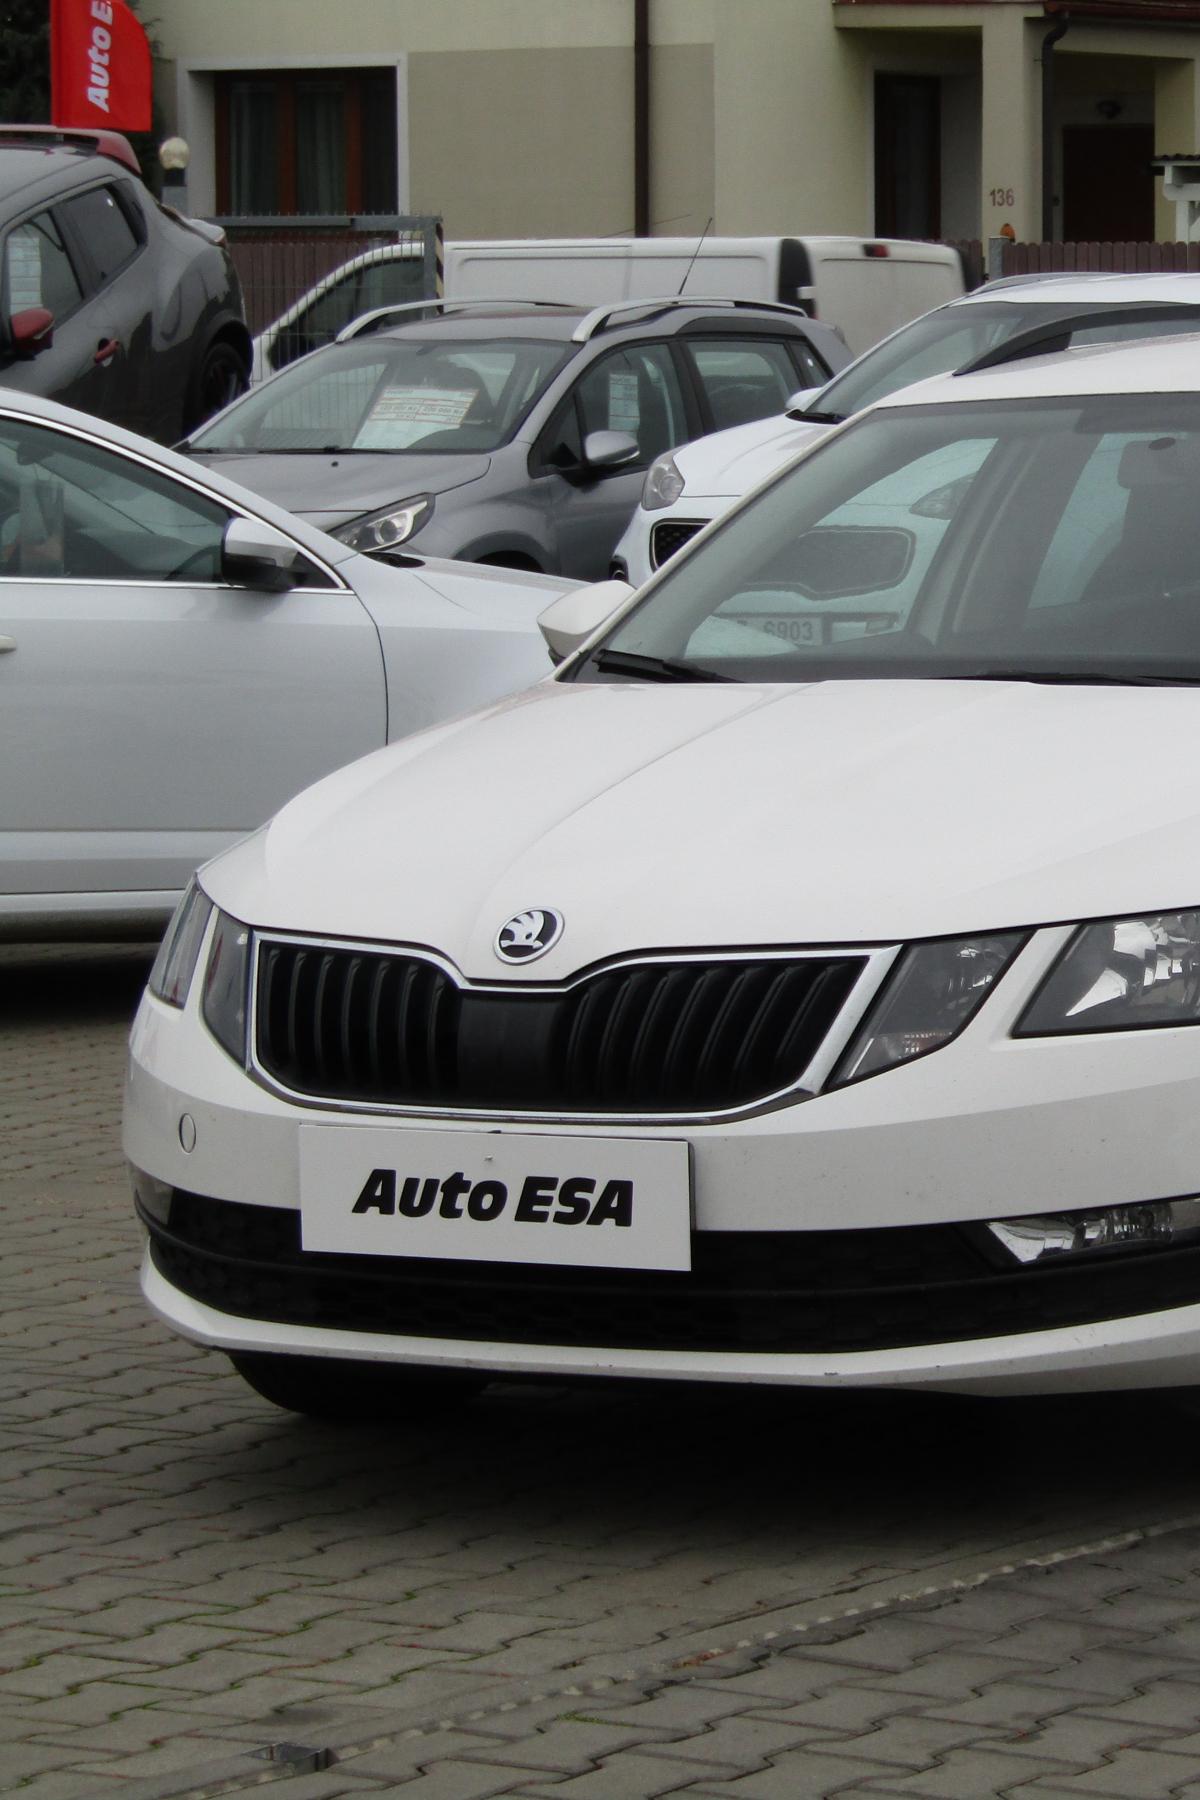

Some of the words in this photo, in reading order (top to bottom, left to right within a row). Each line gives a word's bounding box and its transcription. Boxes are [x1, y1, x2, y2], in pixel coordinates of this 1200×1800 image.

[87, 26, 112, 113] Auto
[990, 188, 1015, 207] 136
[351, 1168, 508, 1222] Auto
[513, 1175, 634, 1227] ESA
